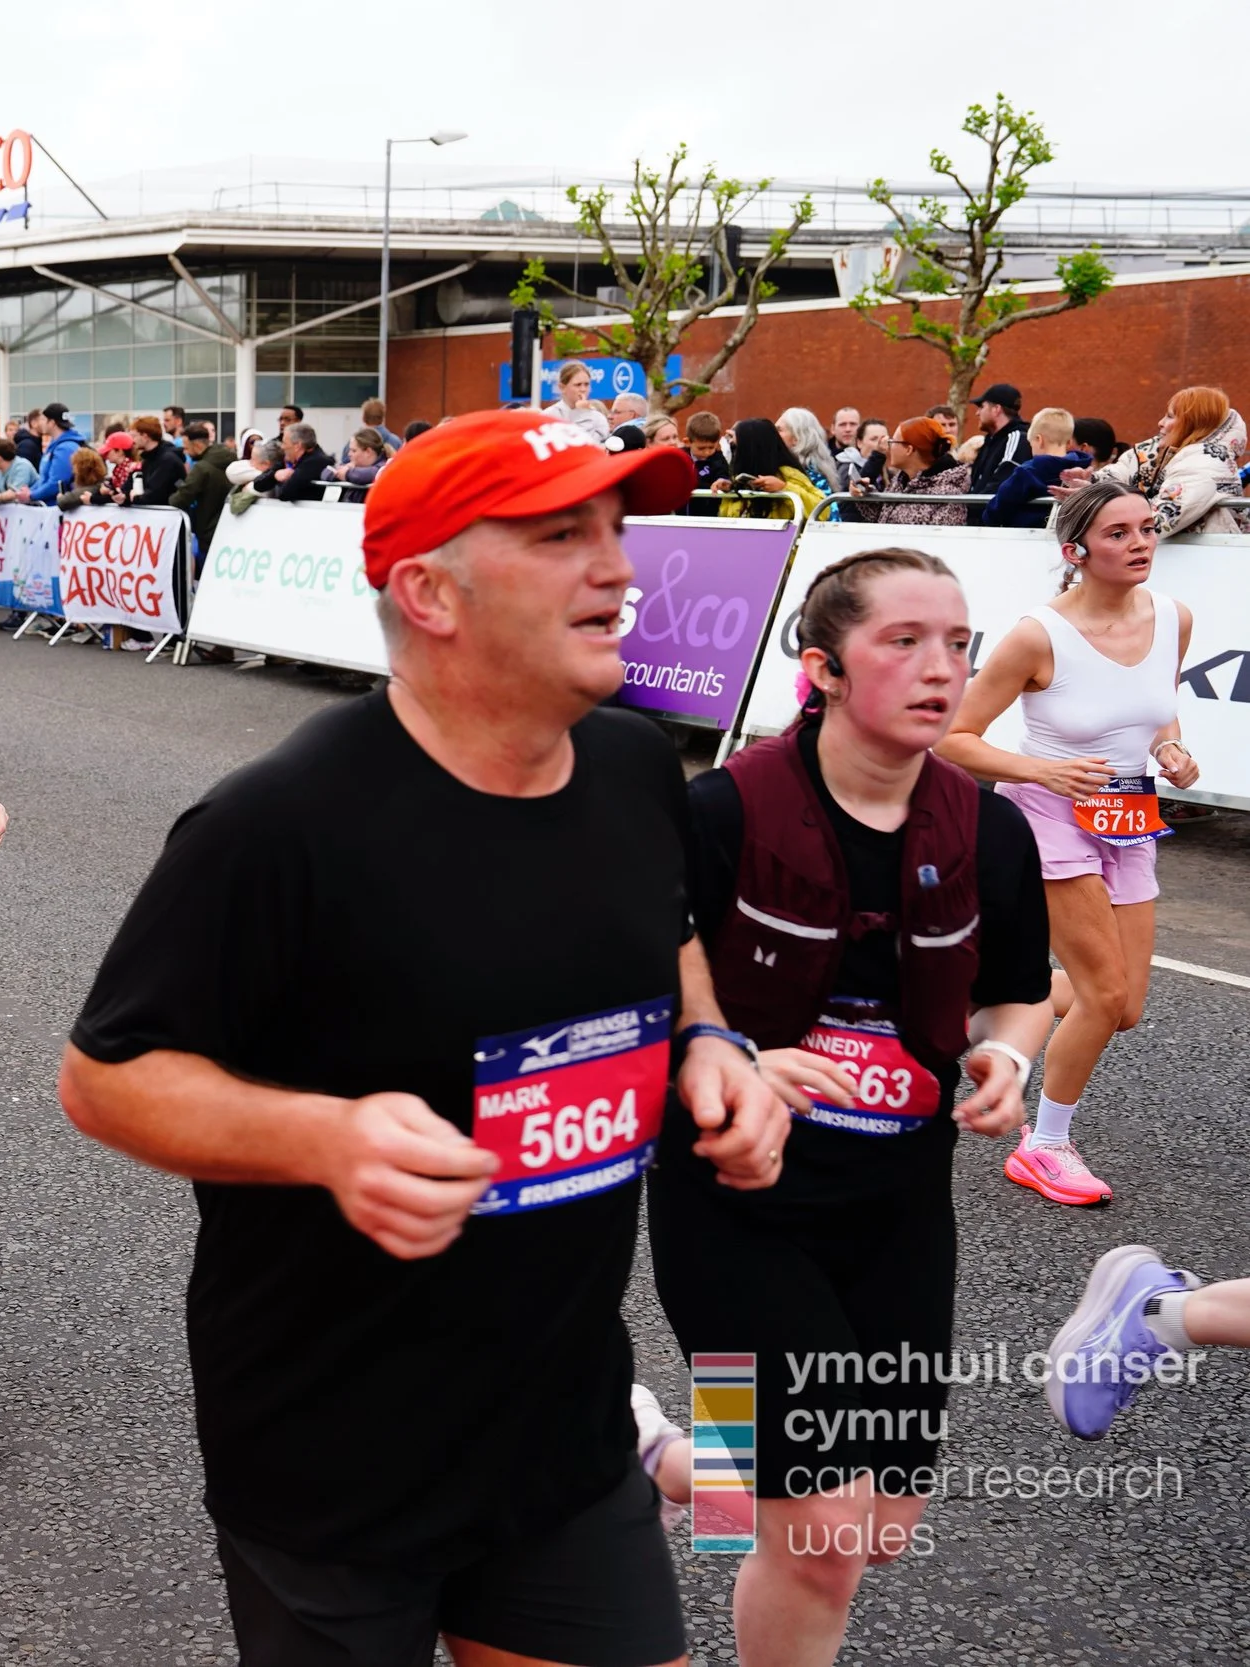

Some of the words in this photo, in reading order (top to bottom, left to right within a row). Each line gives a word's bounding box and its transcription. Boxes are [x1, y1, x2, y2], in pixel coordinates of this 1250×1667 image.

[60, 519, 166, 569] BRECON
[215, 546, 272, 583] core
[279, 552, 343, 592] core
[618, 549, 749, 650] s&co
[620, 661, 726, 697] countants
[1093, 809, 1147, 832] 6713
[801, 1033, 874, 1060] NNEDY
[478, 1082, 551, 1119] MARK
[519, 1088, 639, 1169] 5664
[518, 1158, 636, 1206] #RUNSWANSEA
